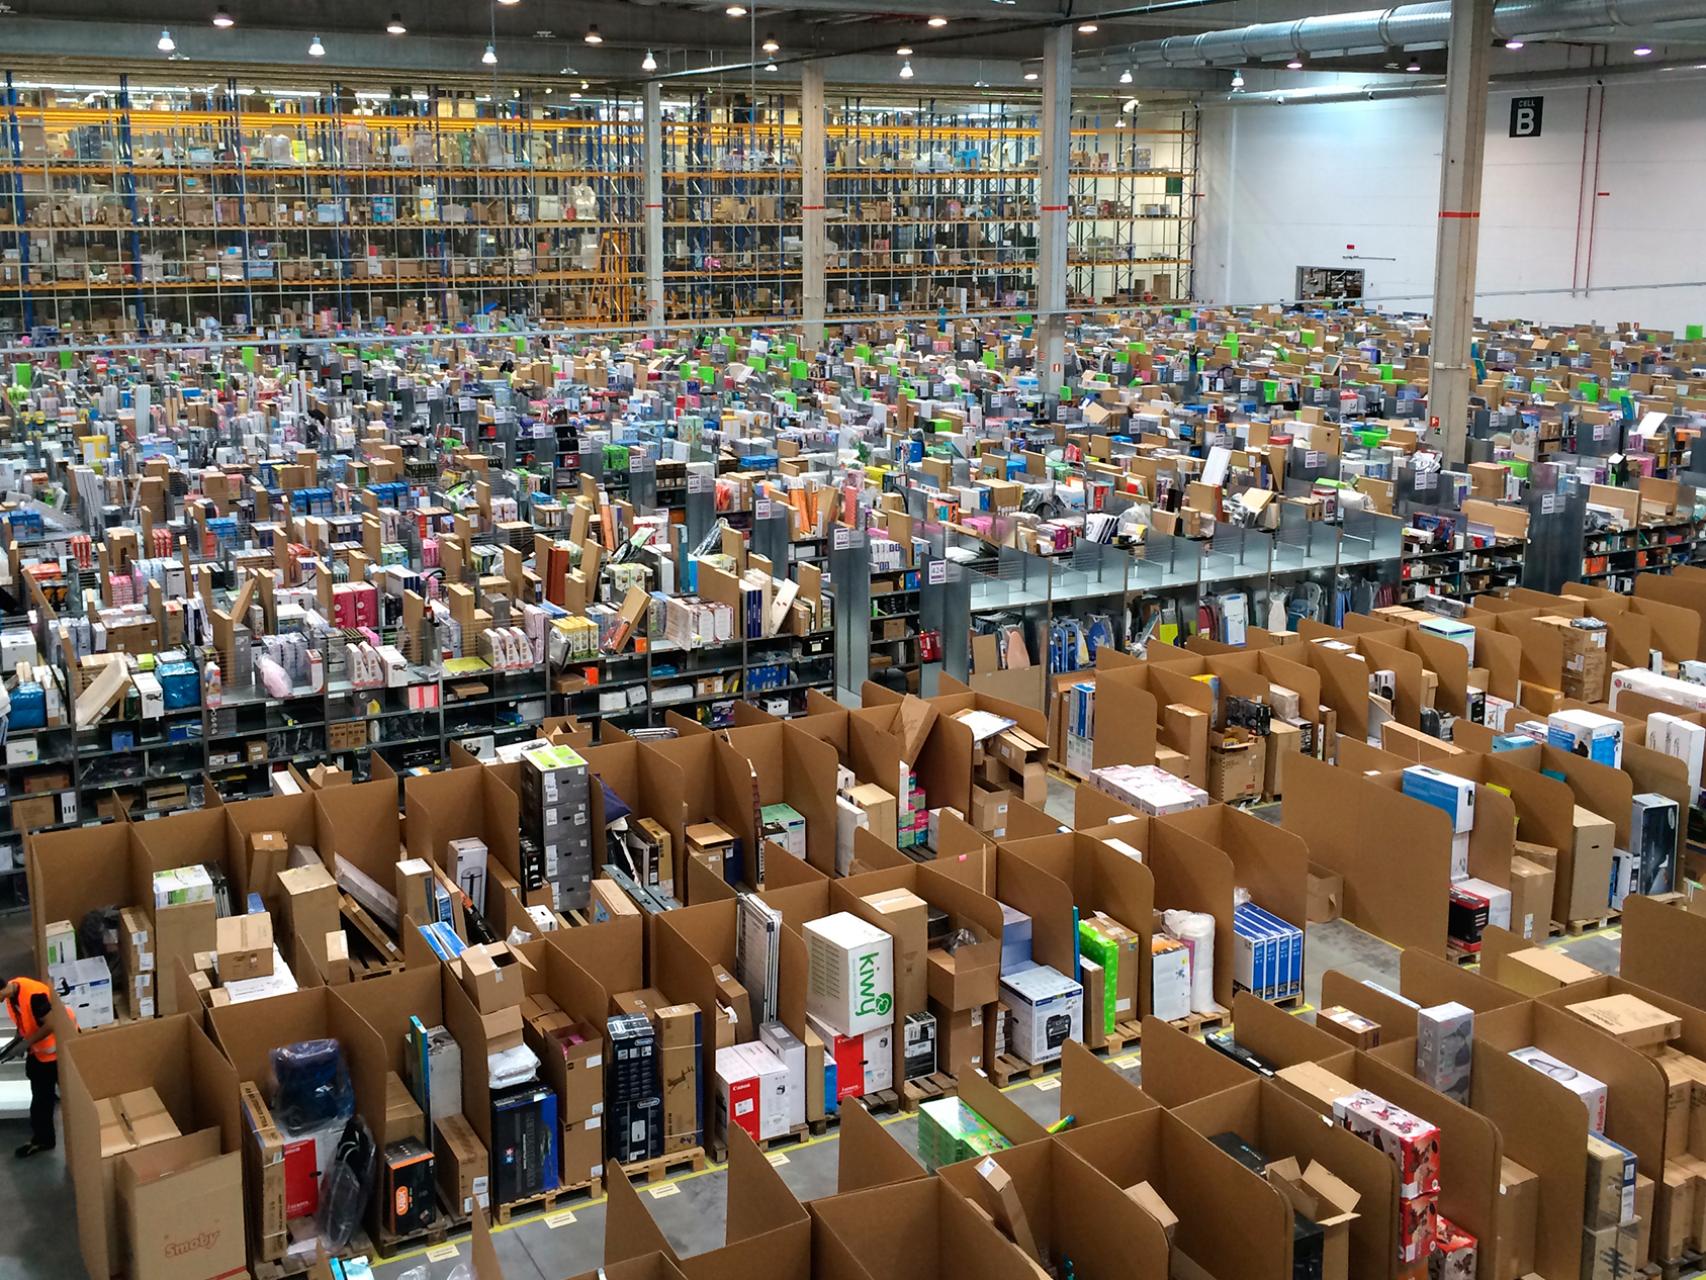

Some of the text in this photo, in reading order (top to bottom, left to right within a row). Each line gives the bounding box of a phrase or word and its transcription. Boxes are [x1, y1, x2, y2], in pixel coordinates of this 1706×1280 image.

[1519, 99, 1535, 107] CELL
[1516, 108, 1534, 135] B
[1623, 681, 1633, 689] LG
[855, 951, 880, 1016] kiwy
[165, 1230, 220, 1257] Smoby
